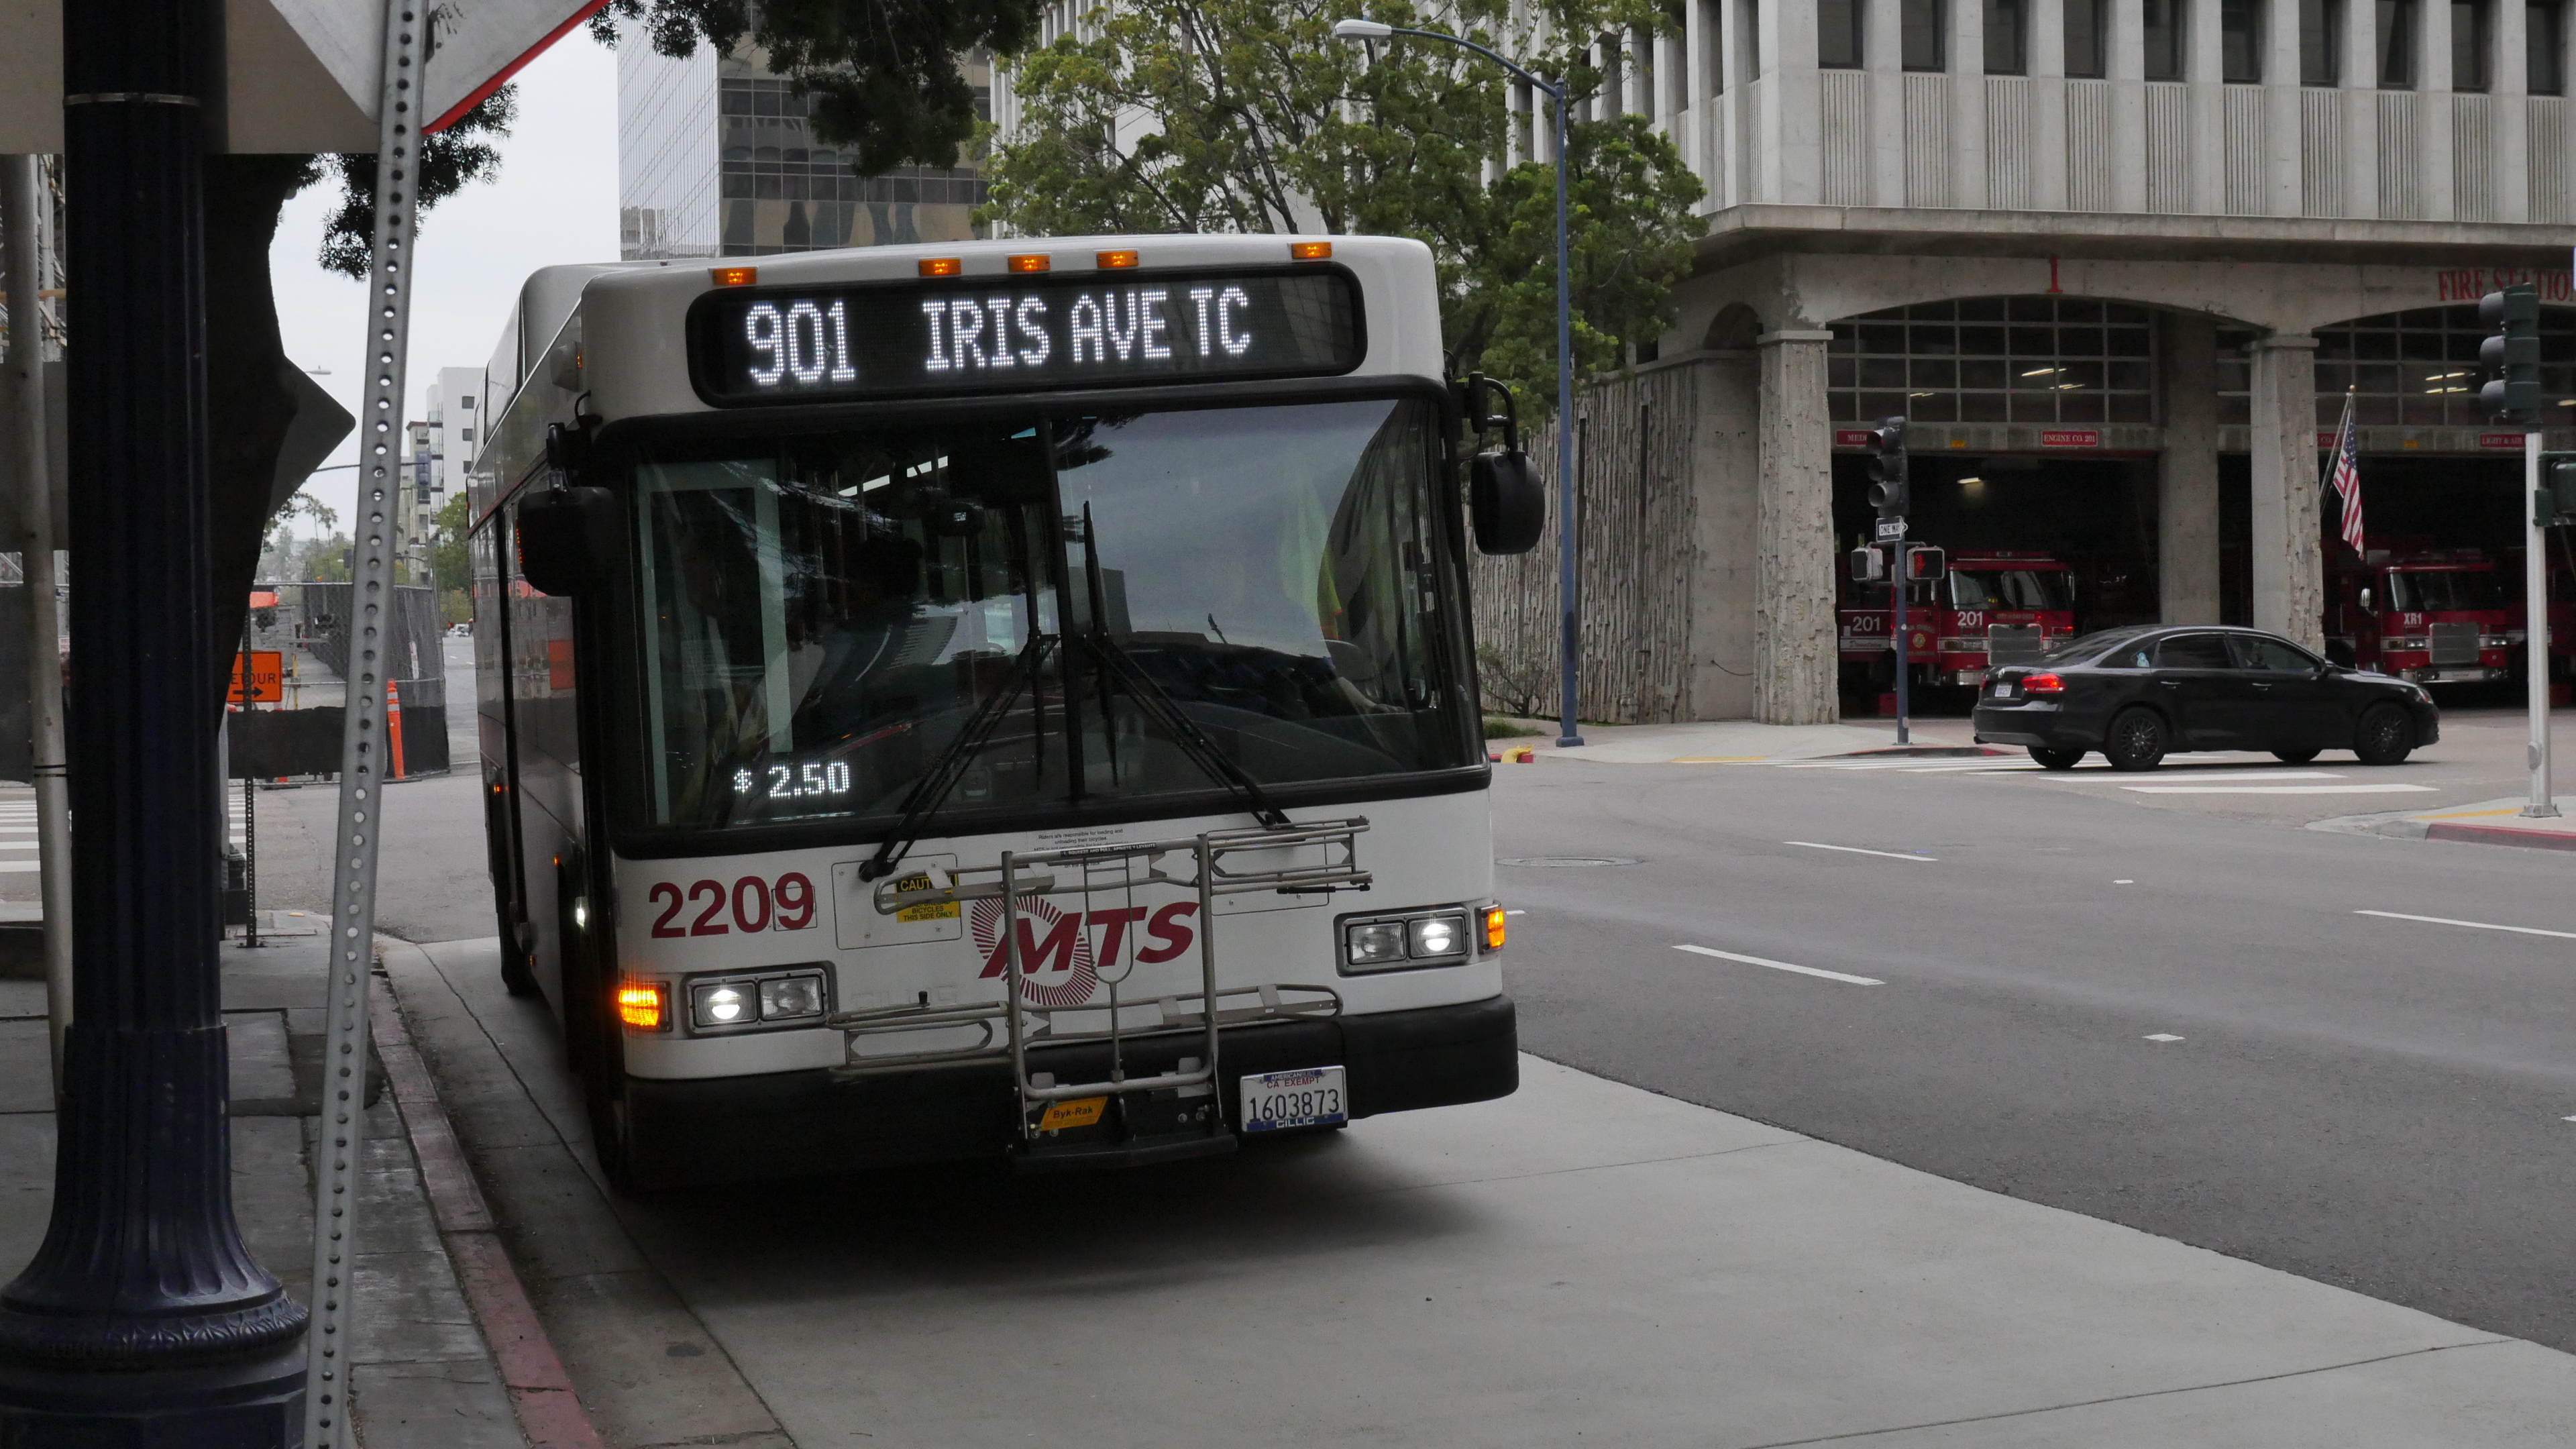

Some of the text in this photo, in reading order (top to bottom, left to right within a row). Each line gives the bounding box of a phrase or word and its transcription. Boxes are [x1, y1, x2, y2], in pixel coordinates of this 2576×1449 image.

[2438, 268, 2574, 301] FIRE STTIO
[745, 286, 1251, 386] 901 IRIS AVE TC
[1880, 525, 1890, 535] ONE
[1852, 616, 1880, 632] 201
[1957, 610, 1983, 626] 201
[733, 761, 850, 798] $ 2.50
[649, 872, 816, 938] 2209
[912, 906, 944, 914] BICYCLES
[978, 902, 1200, 979] MTS
[1267, 1077, 1320, 1089] CA EXEMPT
[1053, 1106, 1093, 1119] Byk-Rak
[1250, 1089, 1340, 1123] 1603873
[1276, 1116, 1315, 1128] GILLIG
